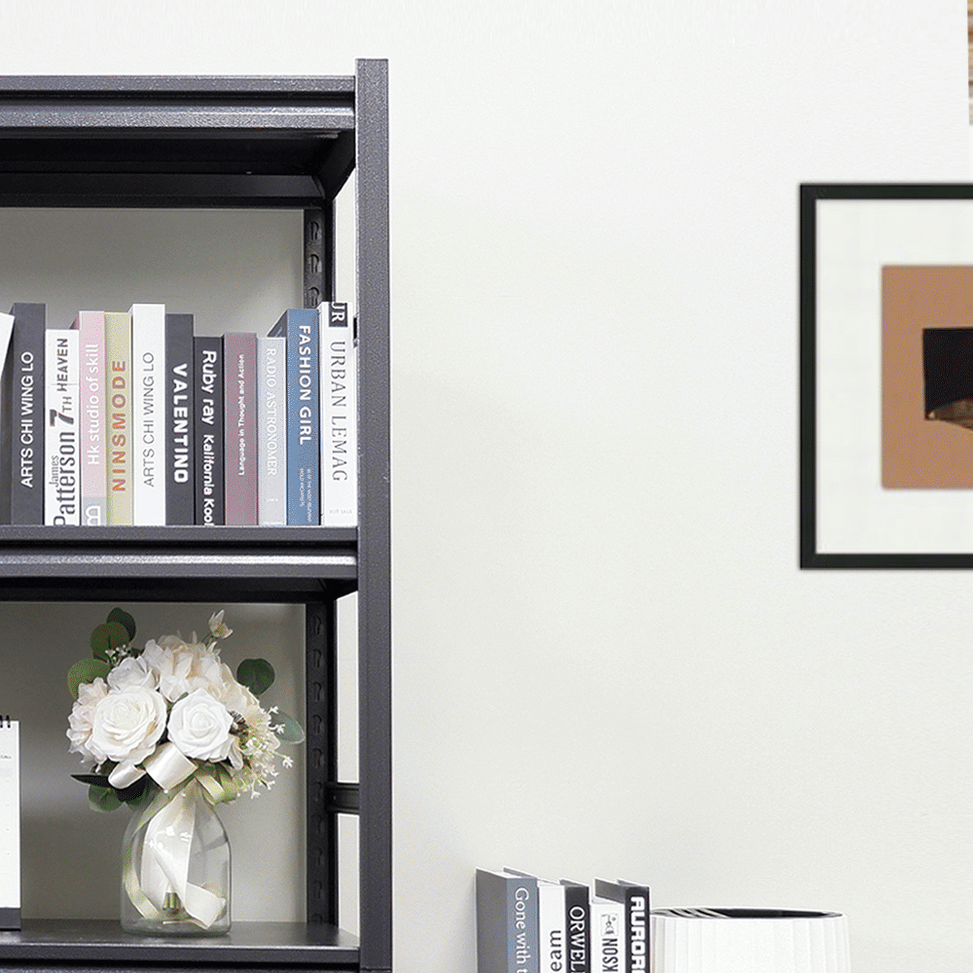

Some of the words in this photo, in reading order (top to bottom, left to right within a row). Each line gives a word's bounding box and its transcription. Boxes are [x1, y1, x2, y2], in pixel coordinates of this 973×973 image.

[21, 352, 33, 372] LO
[56, 338, 68, 392] HEAVEN
[85, 344, 99, 373] skill
[143, 352, 154, 372] LO
[201, 351, 217, 393] Ruby
[265, 348, 277, 387] RADIO
[298, 325, 311, 401] FASHION
[330, 341, 347, 407] URBAN
[21, 376, 33, 415] WING
[86, 376, 100, 391] of
[143, 376, 154, 415] WING
[87, 396, 100, 441] studio
[112, 361, 126, 491] NINSMODE
[173, 363, 188, 483] VALENTINO
[202, 399, 215, 425] ray
[237, 396, 245, 426] Thought
[299, 406, 312, 445] GIRL
[21, 419, 33, 444] CHI
[143, 420, 154, 444] CHI
[238, 428, 244, 436] in
[266, 392, 278, 476] ASTRONOMER
[331, 415, 347, 481] LEMAG
[21, 449, 33, 487] ARTS
[49, 456, 59, 487] James
[87, 447, 99, 464] Hk
[143, 449, 154, 487] ARTS
[203, 435, 215, 495] Kalifornia
[54, 432, 75, 526] Patterson
[515, 887, 528, 929] Gone
[515, 933, 529, 964] with
